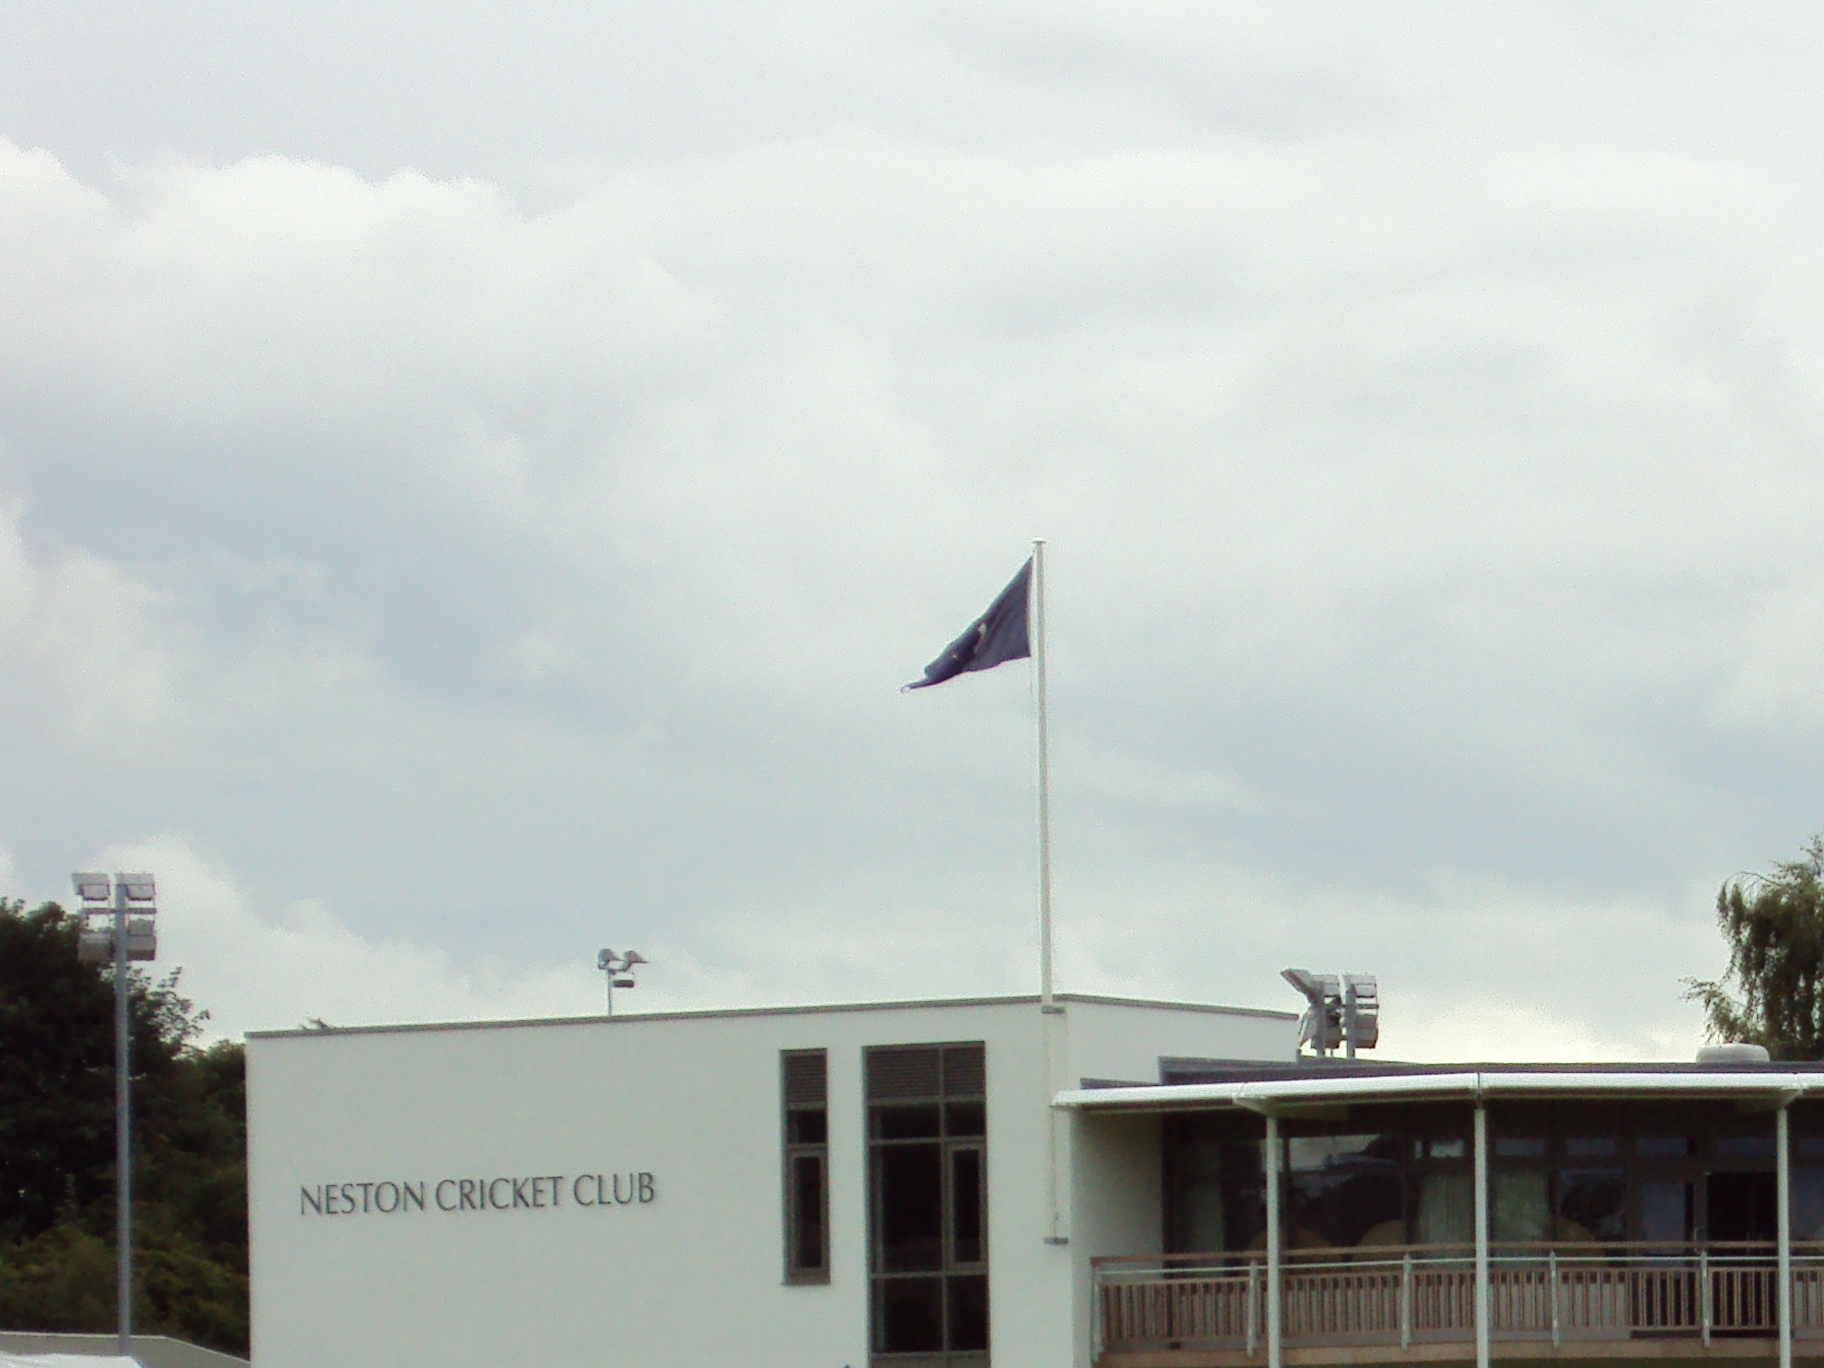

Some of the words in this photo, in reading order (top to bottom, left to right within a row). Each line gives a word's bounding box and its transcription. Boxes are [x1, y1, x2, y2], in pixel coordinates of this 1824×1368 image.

[299, 1180, 427, 1216] NESTON
[434, 1175, 564, 1212] CRICKET
[572, 1171, 657, 1207] CLUB
